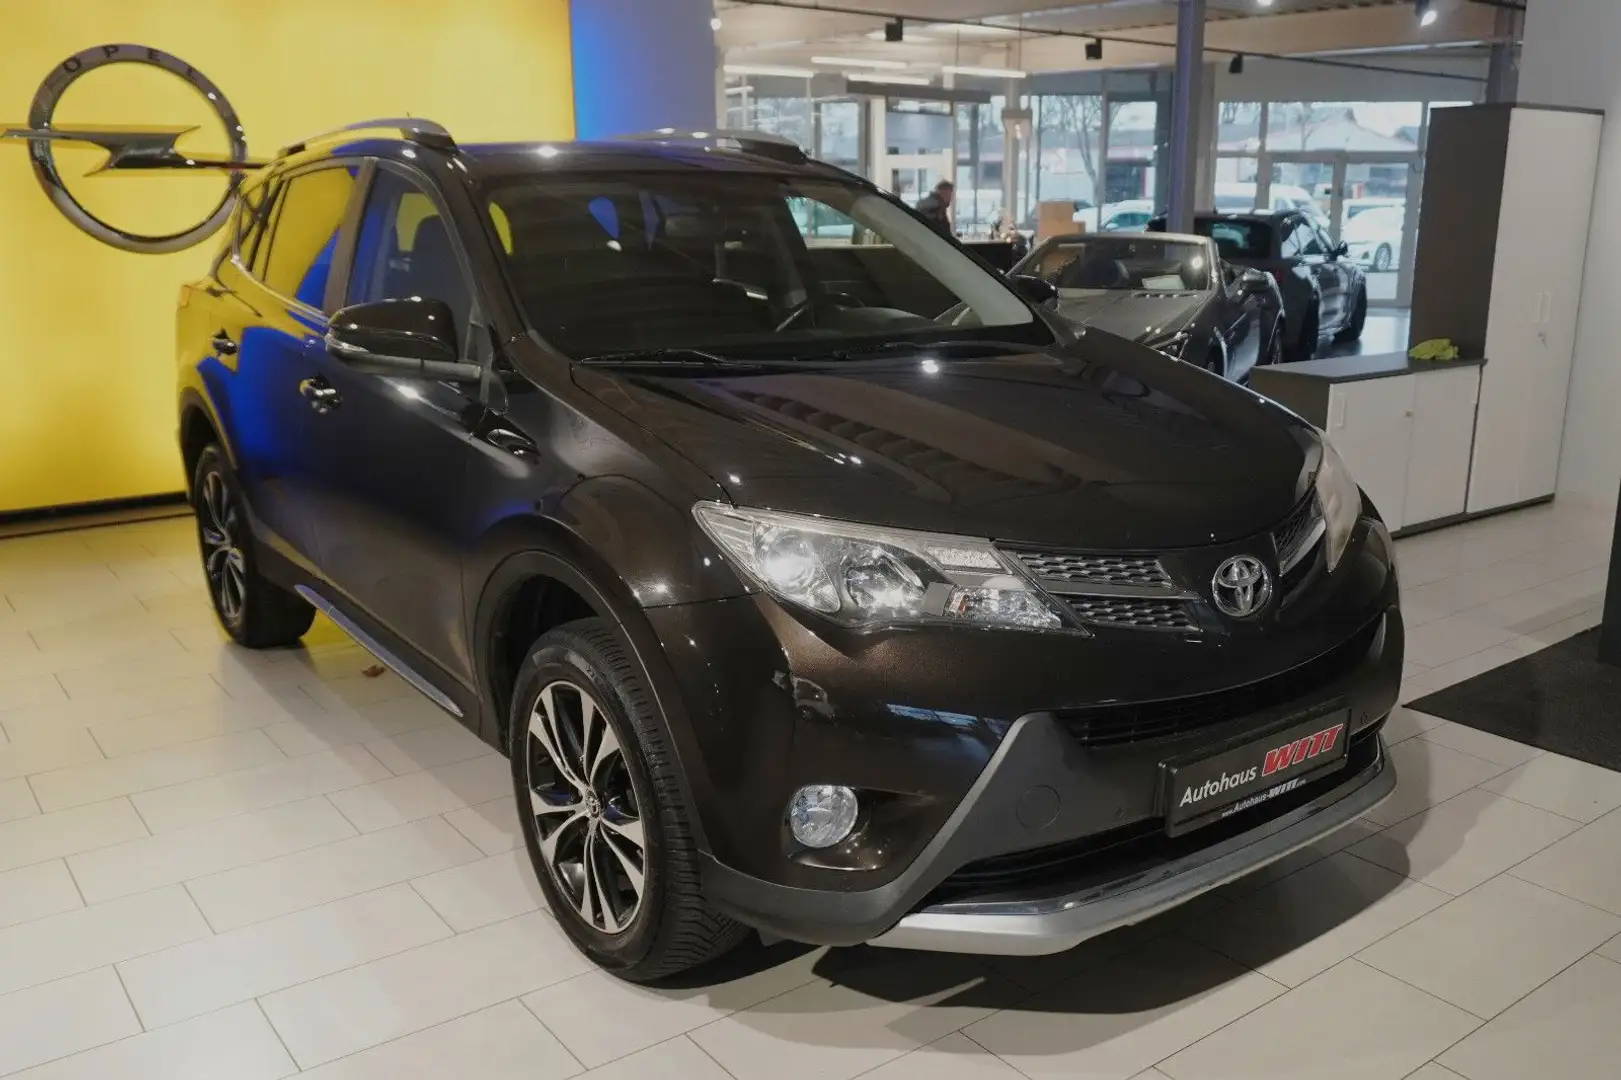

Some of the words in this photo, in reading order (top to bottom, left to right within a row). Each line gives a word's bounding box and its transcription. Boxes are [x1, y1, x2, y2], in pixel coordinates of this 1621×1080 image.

[63, 45, 197, 81] OPEL
[1180, 765, 1257, 807] Autohaus
[1261, 723, 1343, 777] WITT
